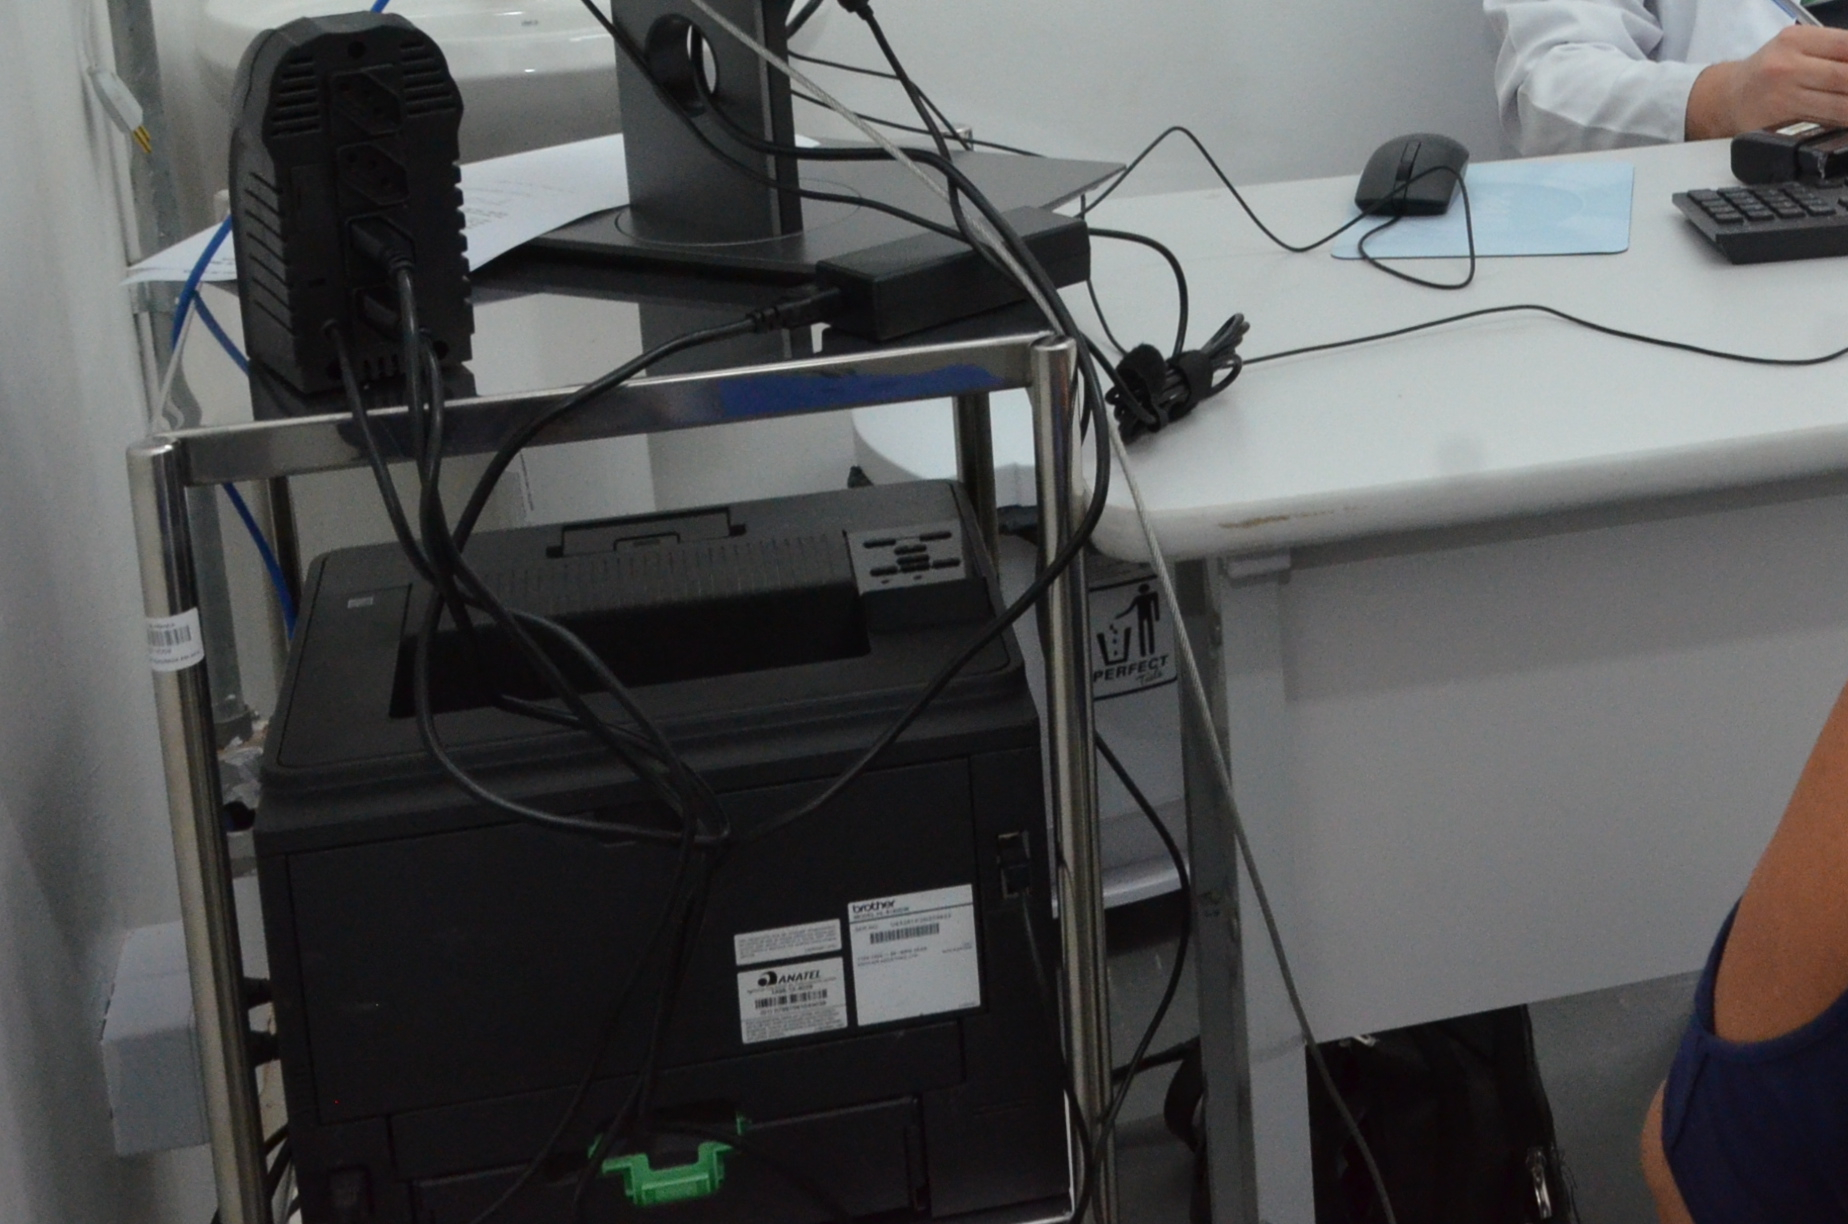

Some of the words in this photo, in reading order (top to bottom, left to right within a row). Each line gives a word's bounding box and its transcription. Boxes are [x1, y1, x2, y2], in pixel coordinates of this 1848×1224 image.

[1093, 655, 1169, 683] PERFECT
[852, 899, 895, 913] brother
[779, 970, 820, 984] ANATEL
